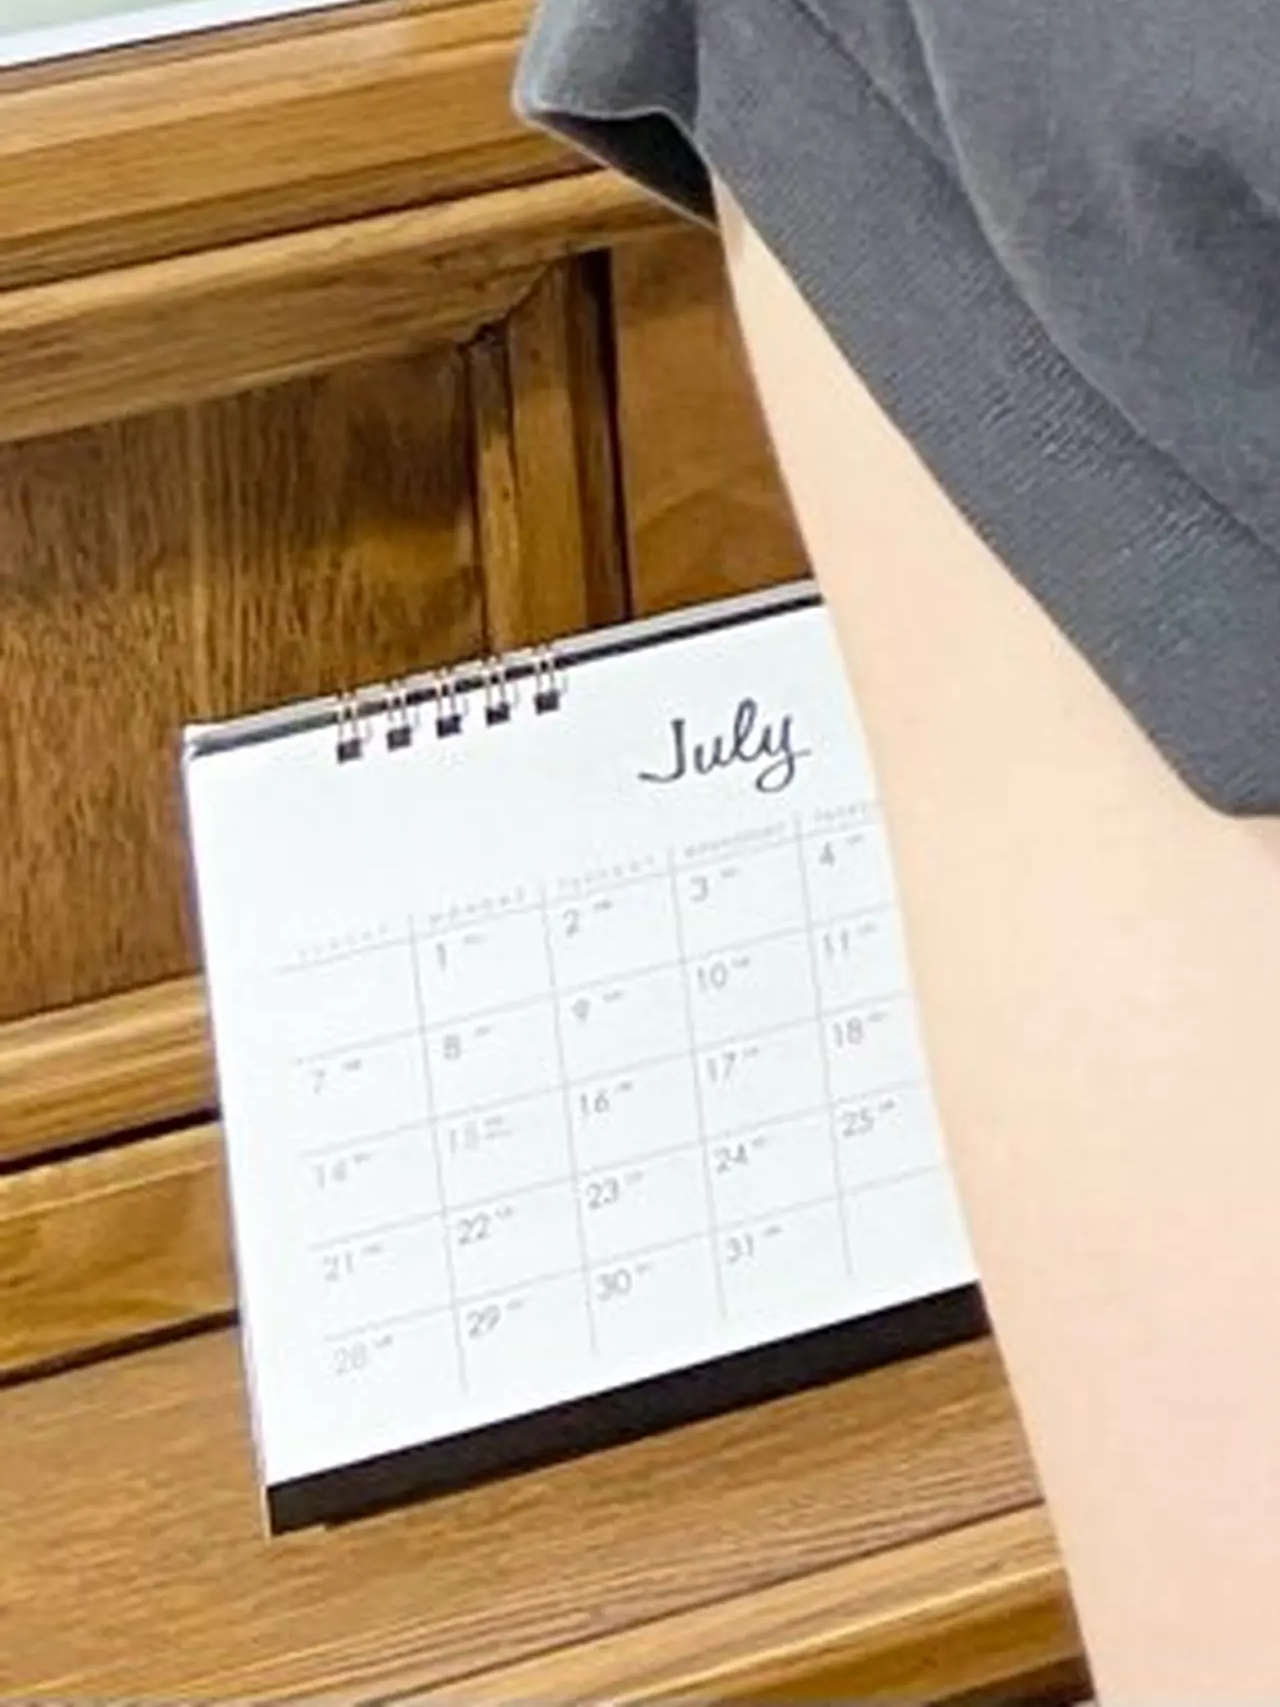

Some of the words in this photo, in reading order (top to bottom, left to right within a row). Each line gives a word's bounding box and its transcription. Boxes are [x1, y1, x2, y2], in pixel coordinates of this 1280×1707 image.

[637, 695, 812, 794] July
[561, 907, 580, 938] 2
[689, 874, 709, 904] 3
[818, 841, 836, 868] 4
[442, 1033, 462, 1061] 8
[696, 961, 730, 993] 10
[822, 927, 850, 960] 11
[579, 1087, 611, 1118] 16
[706, 1050, 738, 1086] 17
[832, 1016, 865, 1048] 18
[322, 1249, 354, 1283] 21
[457, 1210, 493, 1247] 22
[586, 1175, 620, 1211] 23
[713, 1141, 750, 1176] 24
[840, 1105, 875, 1140] 25
[466, 1303, 501, 1341] 29
[596, 1267, 633, 1303] 30
[724, 1232, 755, 1266] 31
